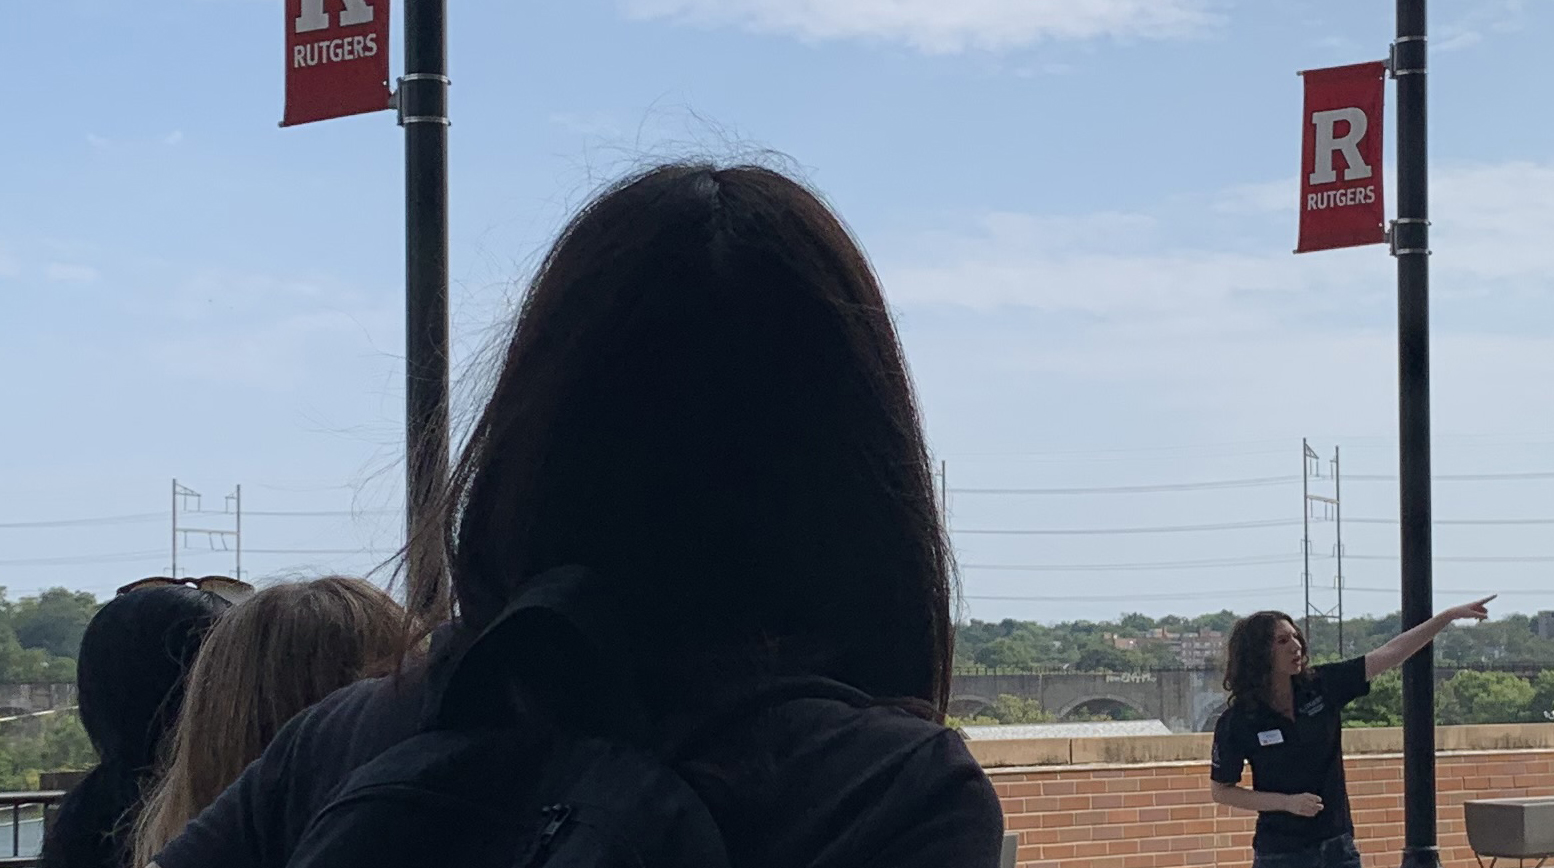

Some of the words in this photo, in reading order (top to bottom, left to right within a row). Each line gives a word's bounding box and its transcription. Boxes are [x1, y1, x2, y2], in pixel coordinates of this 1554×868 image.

[293, 33, 378, 68] RUTGERS
[1309, 107, 1373, 185] R
[1307, 185, 1376, 211] RUTGERS
